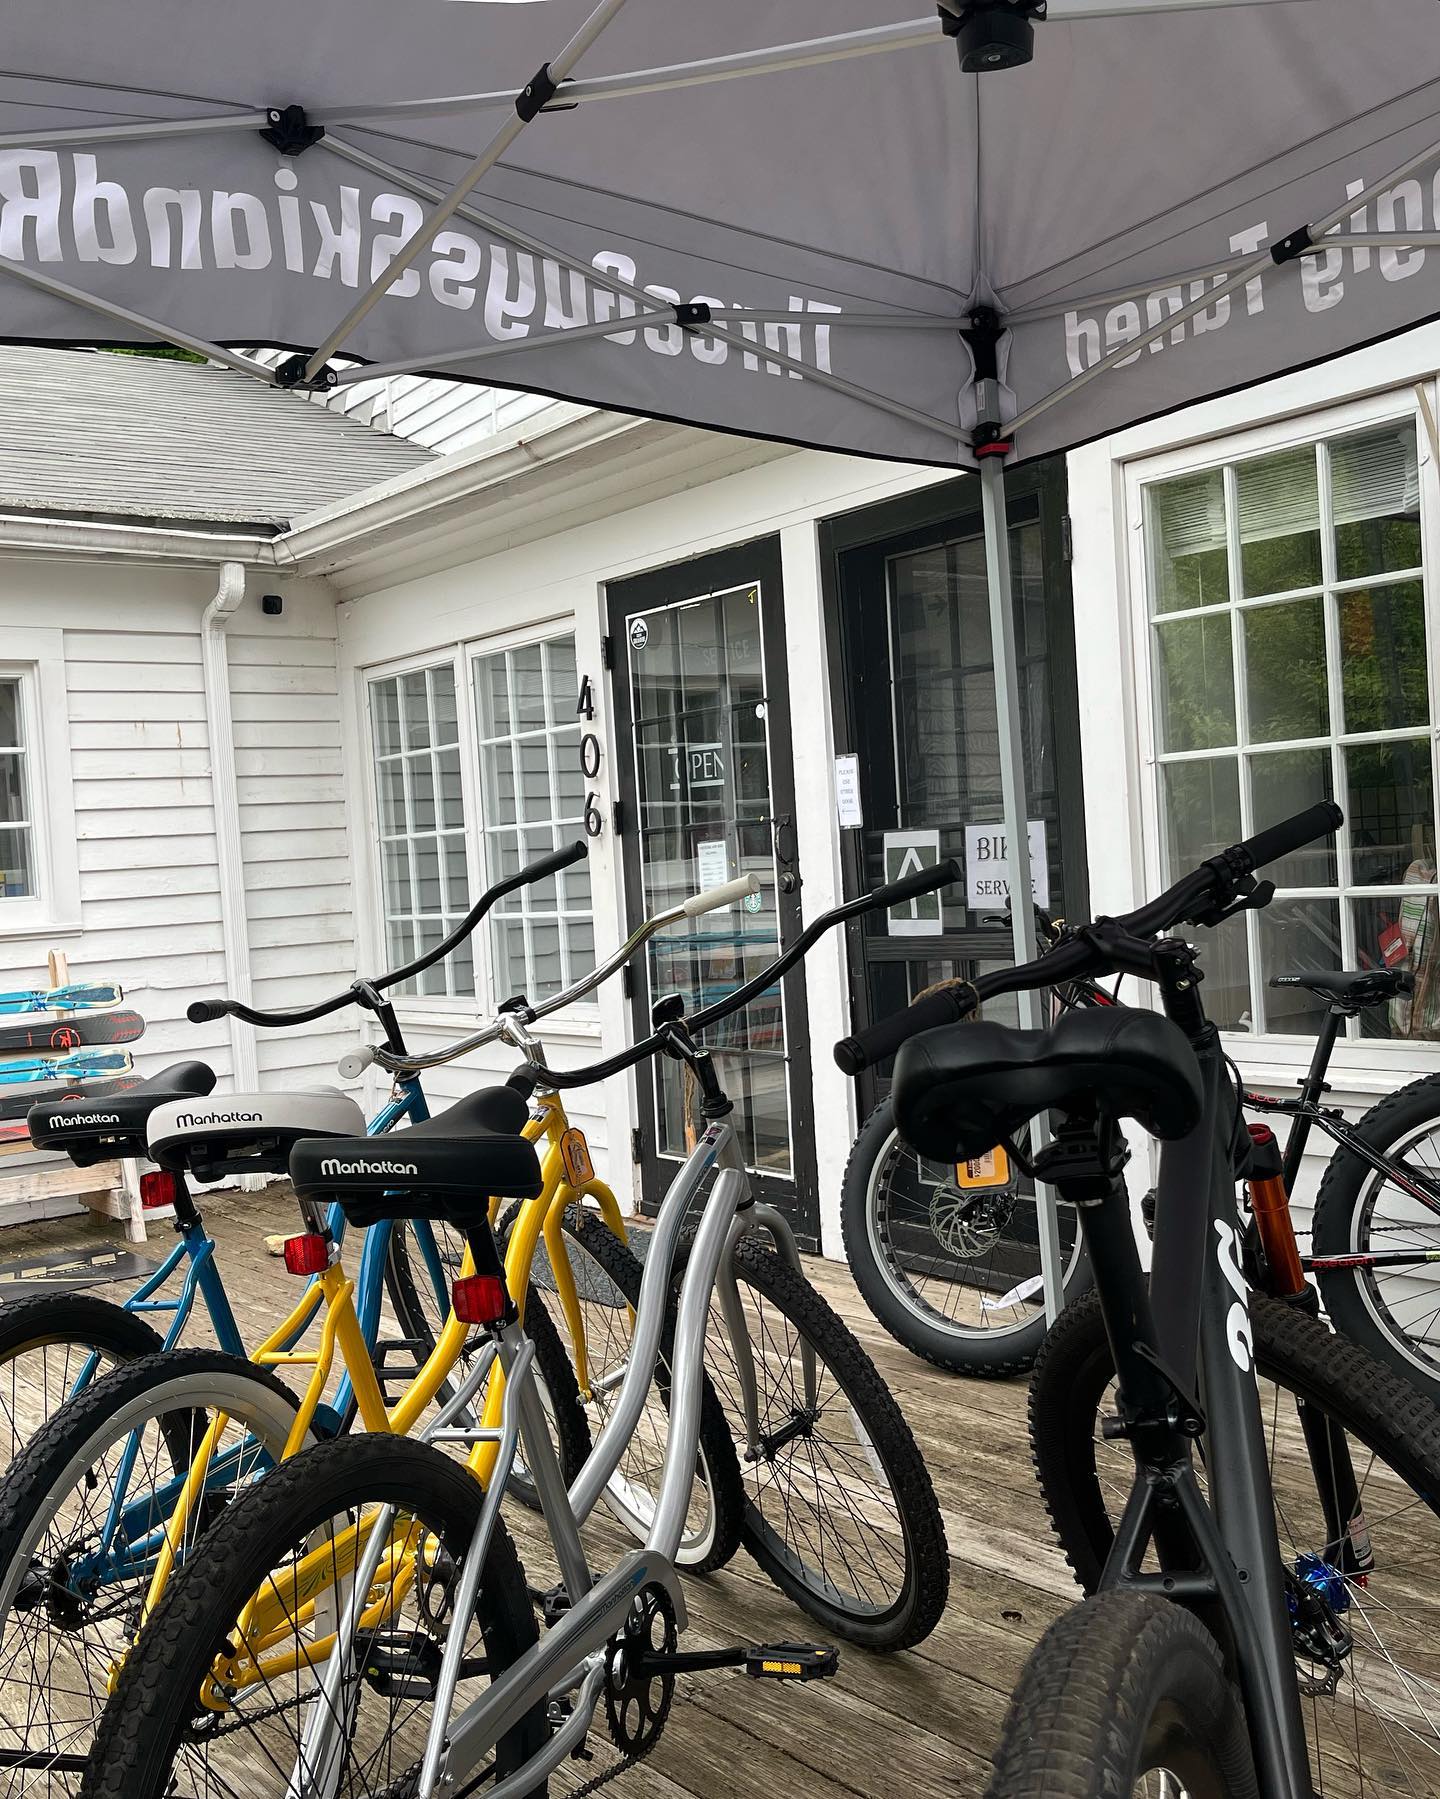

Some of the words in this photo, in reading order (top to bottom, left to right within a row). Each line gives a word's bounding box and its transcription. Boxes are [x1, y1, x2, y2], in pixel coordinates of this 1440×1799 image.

[49, 1114, 120, 1129] Manhattan
[176, 1110, 263, 1129] Manhattan
[321, 1158, 418, 1176] Manhattan
